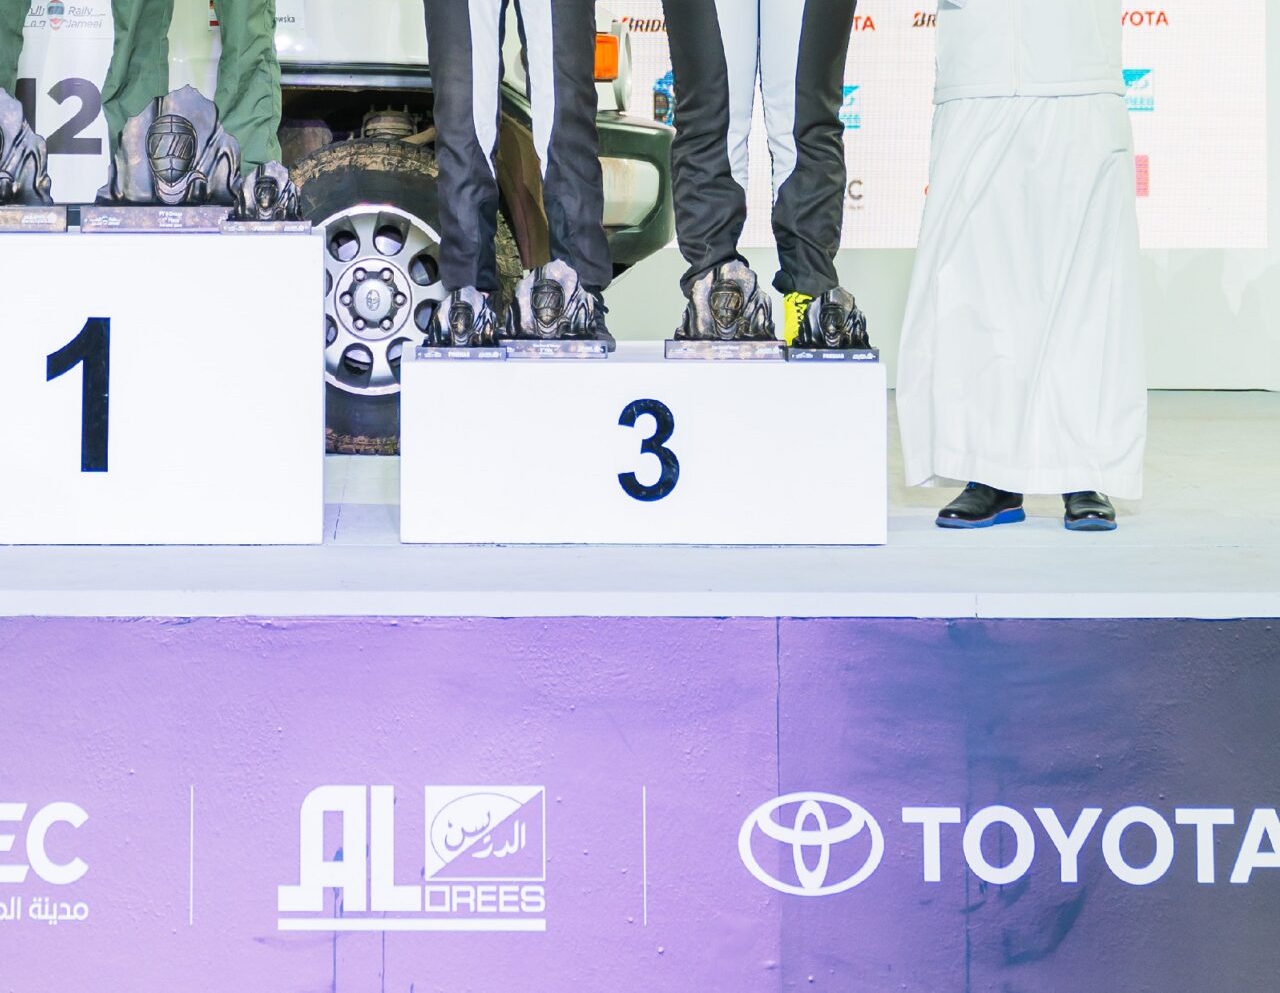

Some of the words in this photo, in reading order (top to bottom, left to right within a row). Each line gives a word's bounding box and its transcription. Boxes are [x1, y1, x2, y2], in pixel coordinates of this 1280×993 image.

[1122, 11, 1169, 27] YOTA
[46, 316, 112, 473] 1
[617, 398, 681, 503] 3
[277, 784, 422, 912] AL
[901, 804, 1280, 886] TOYOTA
[28, 895, 90, 922] مدينة
